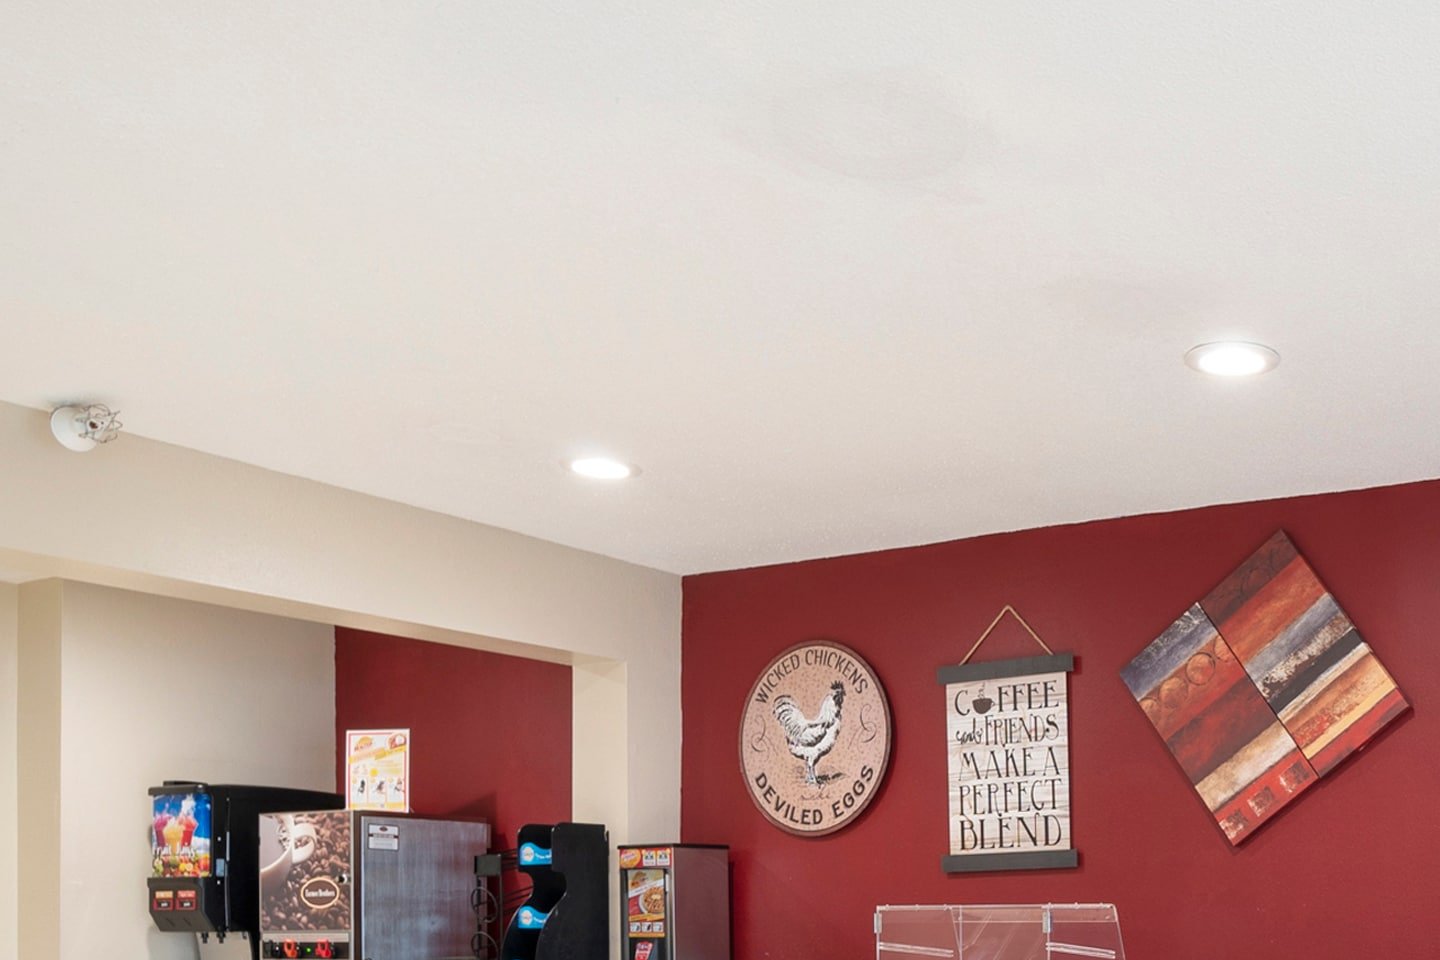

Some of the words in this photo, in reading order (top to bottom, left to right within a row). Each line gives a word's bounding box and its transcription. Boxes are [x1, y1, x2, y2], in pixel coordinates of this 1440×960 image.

[755, 654, 801, 704] WICKED
[804, 649, 869, 694] CHICKENS
[984, 713, 1060, 748] FRIENDS
[958, 746, 1036, 781] MAKE
[1042, 746, 1060, 777] A
[755, 772, 824, 825] DEVILED
[831, 765, 874, 818] EGGS
[959, 778, 1062, 816] PERFECT
[959, 812, 1062, 850] BLEND
